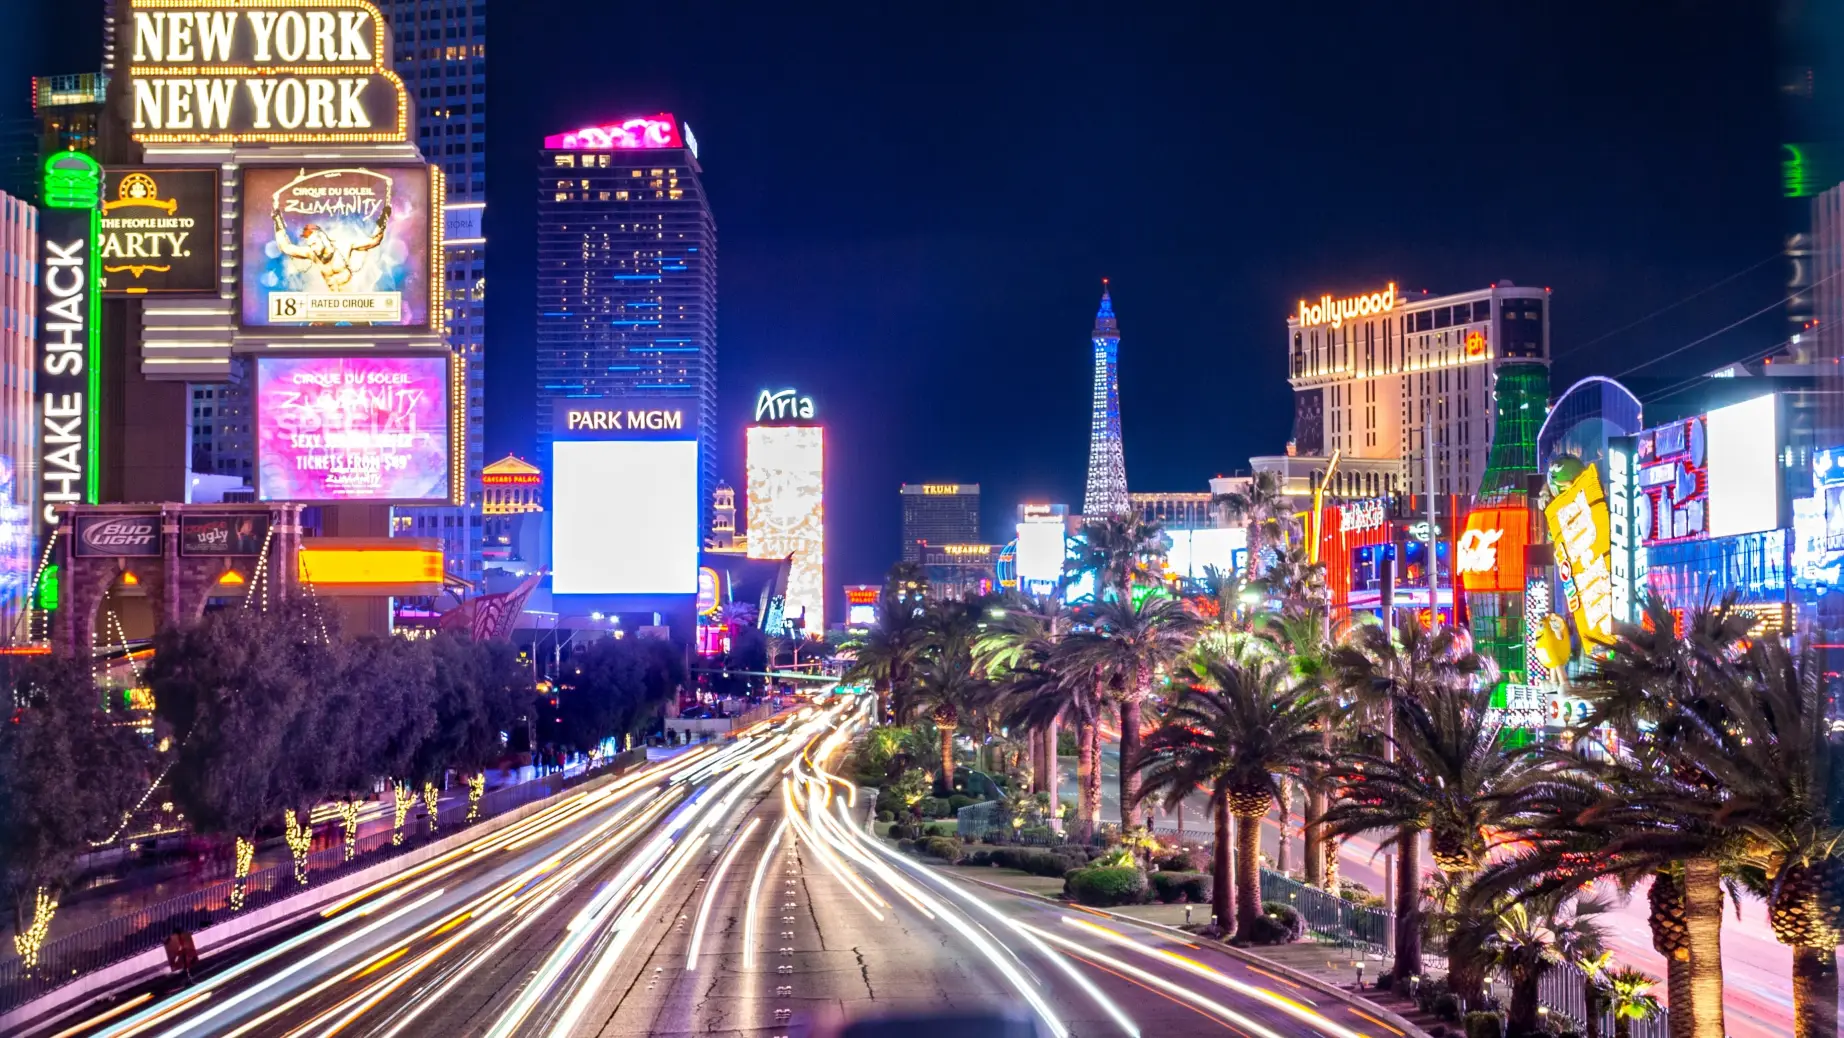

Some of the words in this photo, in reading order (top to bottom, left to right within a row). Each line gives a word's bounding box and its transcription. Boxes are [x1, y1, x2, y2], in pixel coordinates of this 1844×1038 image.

[133, 11, 238, 62] NEW
[247, 11, 372, 62] YORK
[132, 78, 237, 129] NEW
[246, 78, 371, 129] YORK
[292, 187, 326, 198] CIRQUE
[327, 187, 342, 196] DU
[343, 187, 375, 196] SOLEIL
[284, 195, 383, 221] ZUMANITY
[101, 218, 120, 229] THE
[121, 218, 156, 229] PEOPLE
[157, 218, 178, 229] LIKE
[179, 217, 195, 228] TO
[45, 238, 84, 376] SHACK
[311, 299, 340, 308] RATED
[342, 299, 375, 308] CIRQUE
[1300, 282, 1395, 329] hollywood
[292, 372, 341, 387] CIRQUE
[344, 372, 365, 385] DU
[367, 372, 413, 385] SOLEIL
[755, 389, 815, 422] Aria
[568, 410, 622, 430] PARK
[627, 410, 682, 430] MGM
[922, 485, 959, 495] TRUMP
[103, 524, 153, 535] BUD
[197, 527, 229, 544] ugly
[1608, 448, 1630, 624] SKECHERS
[91, 535, 156, 545] LIGHT
